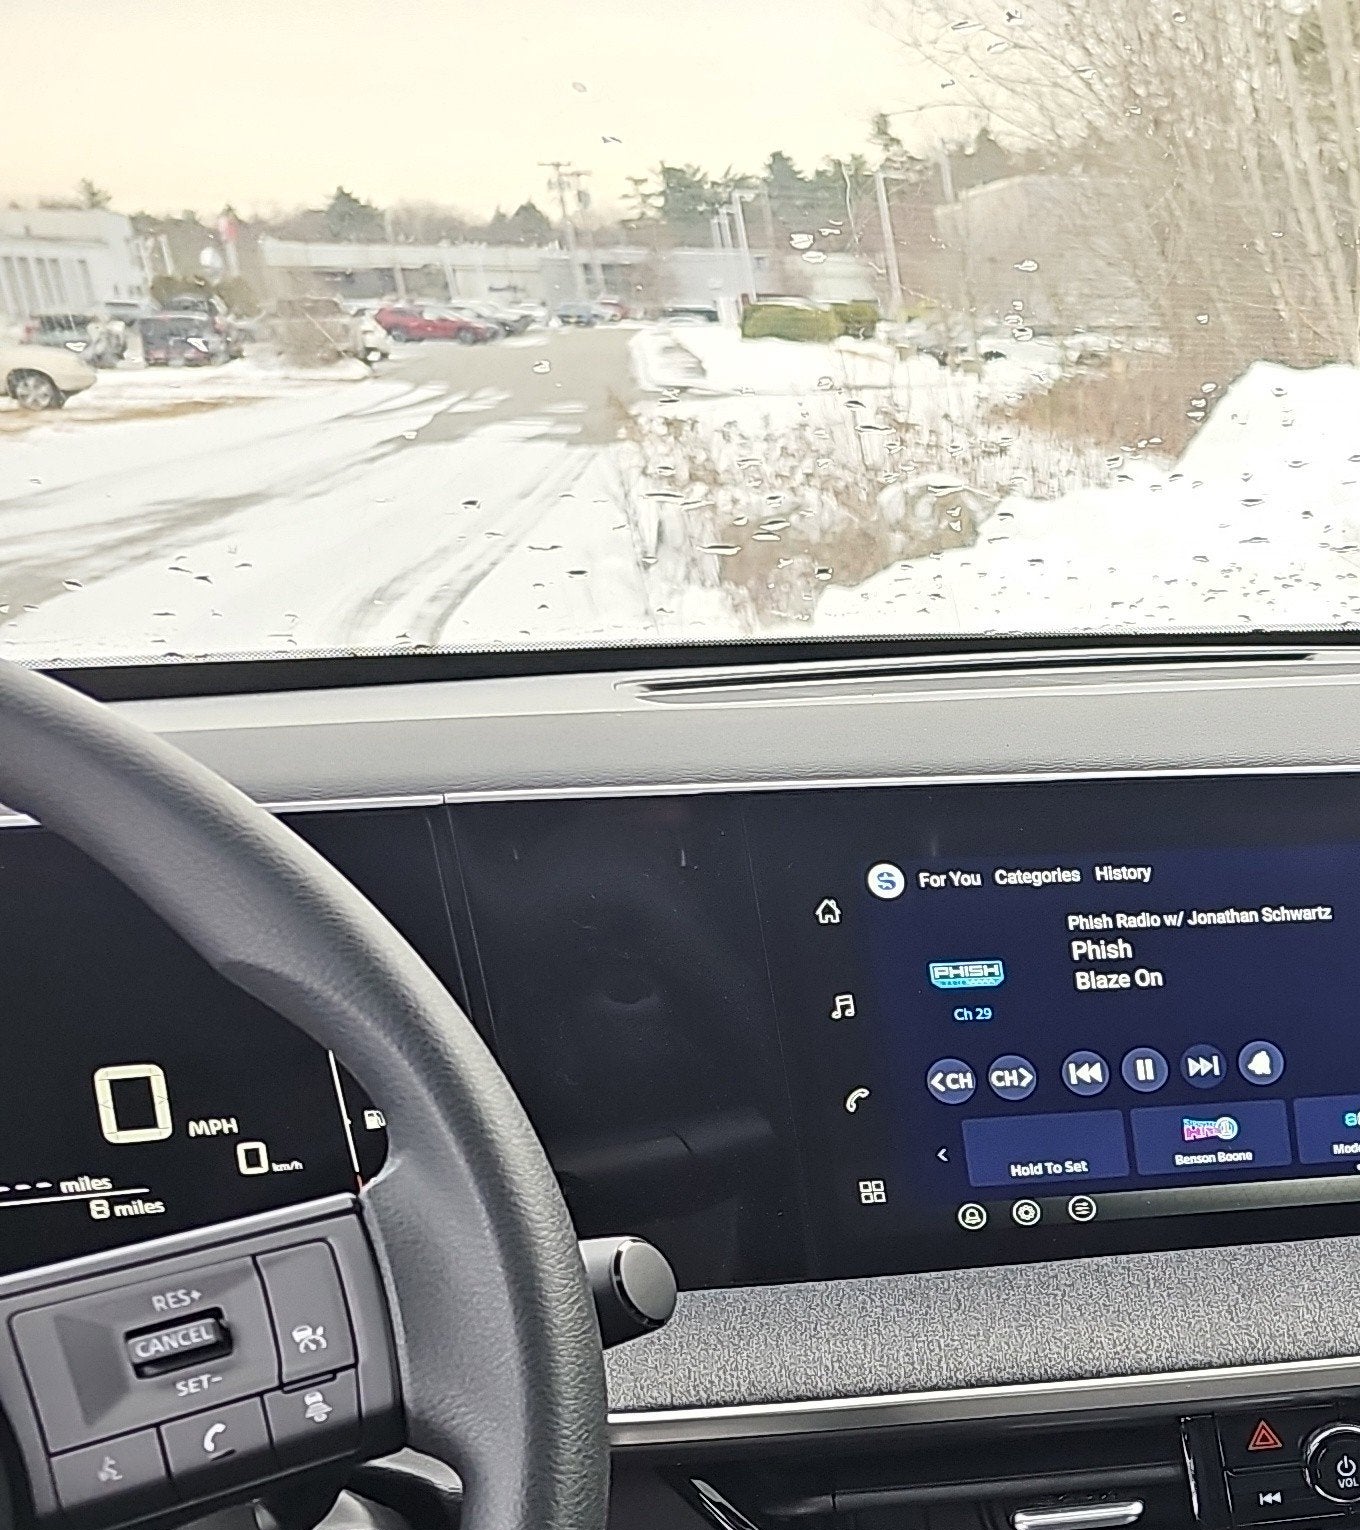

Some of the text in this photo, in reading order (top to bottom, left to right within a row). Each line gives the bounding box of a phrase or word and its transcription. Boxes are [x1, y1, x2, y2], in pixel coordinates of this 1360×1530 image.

[918, 870, 982, 888] For You
[994, 867, 1082, 887] Categories
[1095, 865, 1152, 882] History
[1067, 906, 1333, 931] Phish Radio w/ Jonathan Schwartz
[1071, 938, 1133, 960] Phish
[934, 964, 1000, 979] PHISH
[1075, 968, 1164, 990] Blaze On
[954, 1007, 992, 1020] Ch 29
[94, 1064, 239, 1144] 0 MPH
[236, 1141, 303, 1175] 0 km/h
[1175, 1150, 1253, 1165] Benson Boone
[1010, 1160, 1088, 1177] Hold To Set
[60, 1175, 113, 1194] miles
[89, 1199, 165, 1220] 8 miles
[135, 1326, 214, 1358] CANCEL
[1337, 1477, 1359, 1488] VOL
